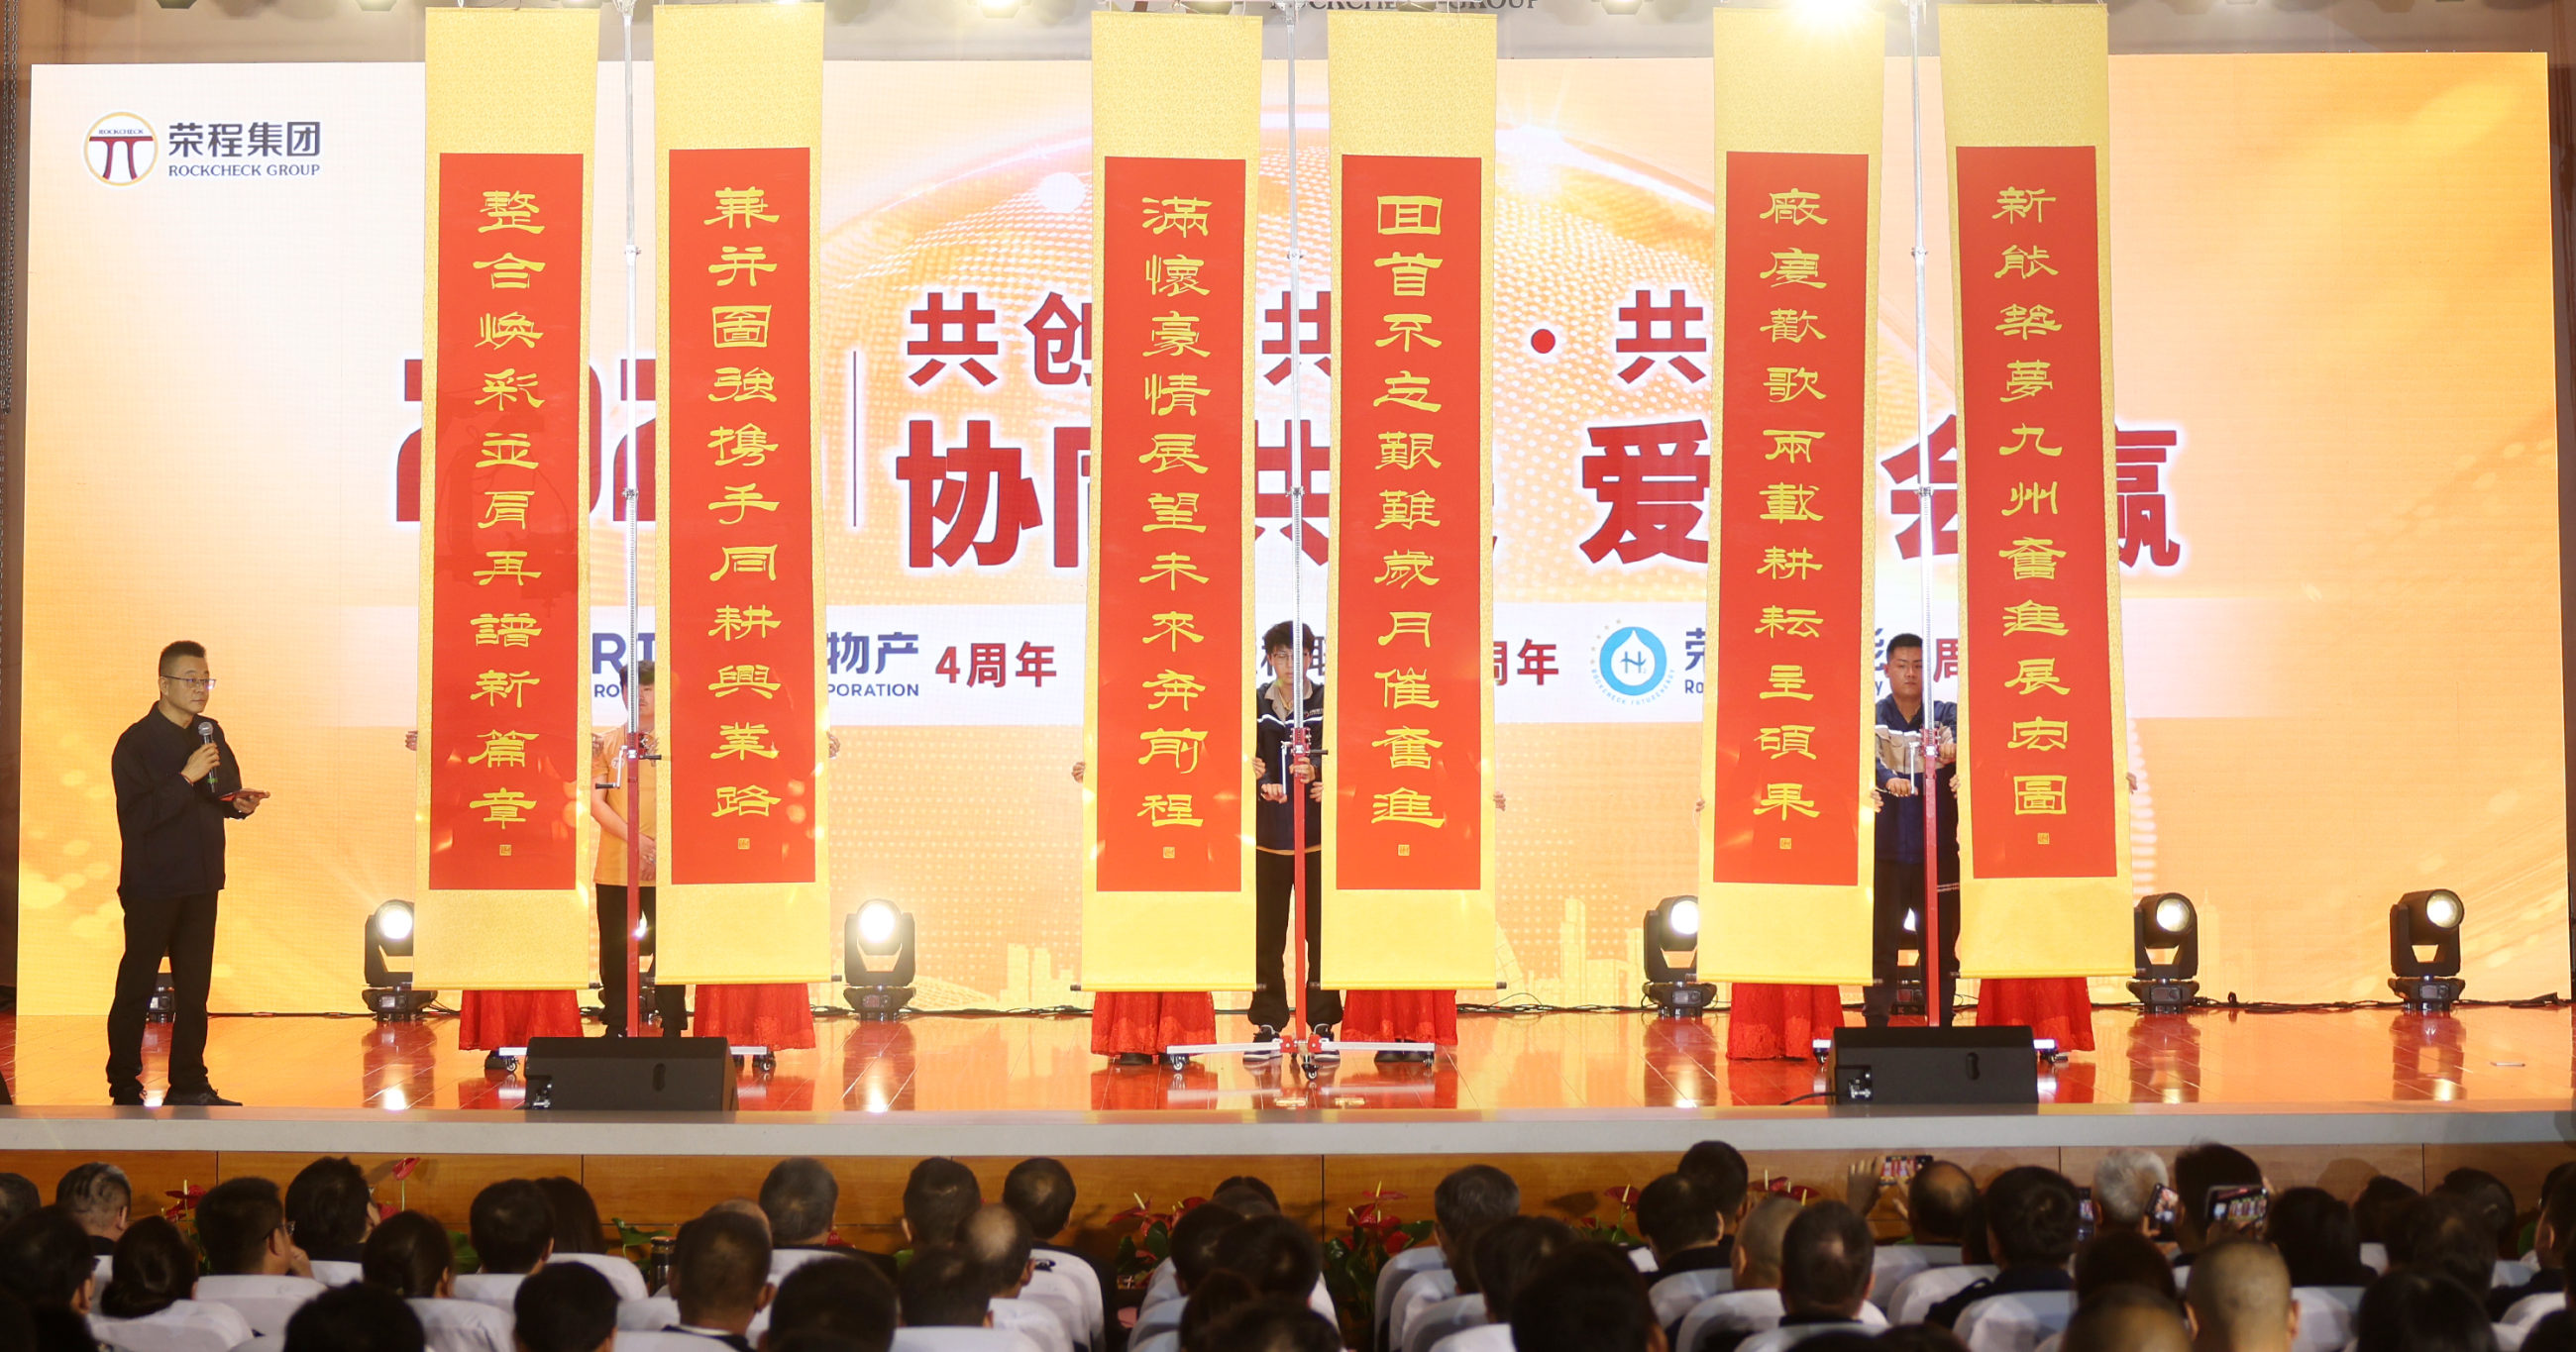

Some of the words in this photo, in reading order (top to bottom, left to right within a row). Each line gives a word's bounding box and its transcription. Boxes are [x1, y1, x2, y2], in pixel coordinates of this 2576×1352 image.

[168, 121, 321, 157] 荣程集团
[168, 164, 262, 176] ROCKCHECK
[266, 164, 320, 176] GROUP
[935, 641, 1057, 688] 4周年
